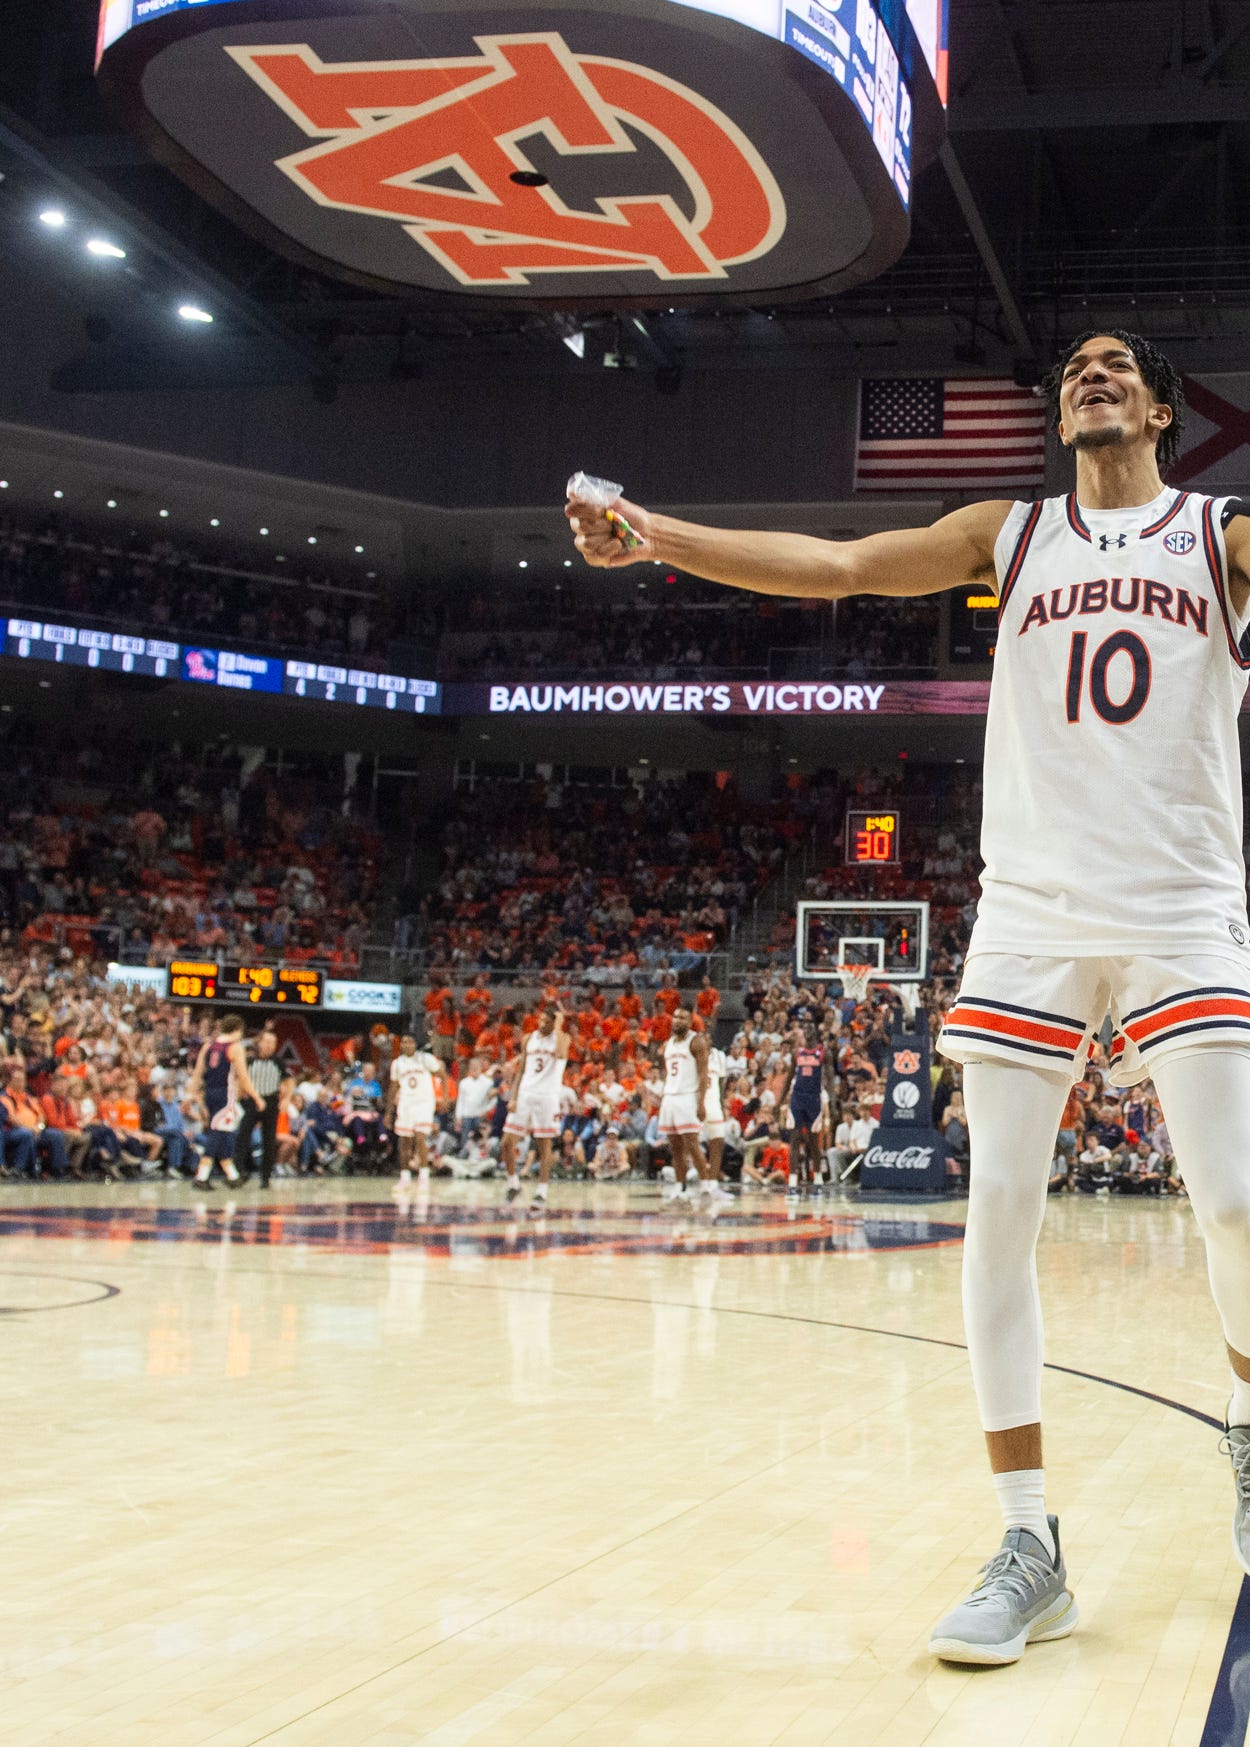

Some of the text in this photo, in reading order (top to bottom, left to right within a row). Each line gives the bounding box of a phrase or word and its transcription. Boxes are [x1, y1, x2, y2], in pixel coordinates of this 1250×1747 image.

[1165, 532, 1194, 553] SEC
[1017, 577, 1209, 637] AUBURN
[1065, 628, 1152, 726] 10
[489, 684, 886, 713] BAUMHOWER'S VICTORY
[866, 816, 895, 833] 1:40
[856, 831, 891, 860] 30
[172, 975, 202, 997] 103
[238, 967, 274, 988] 1:40
[297, 984, 319, 1005] 72
